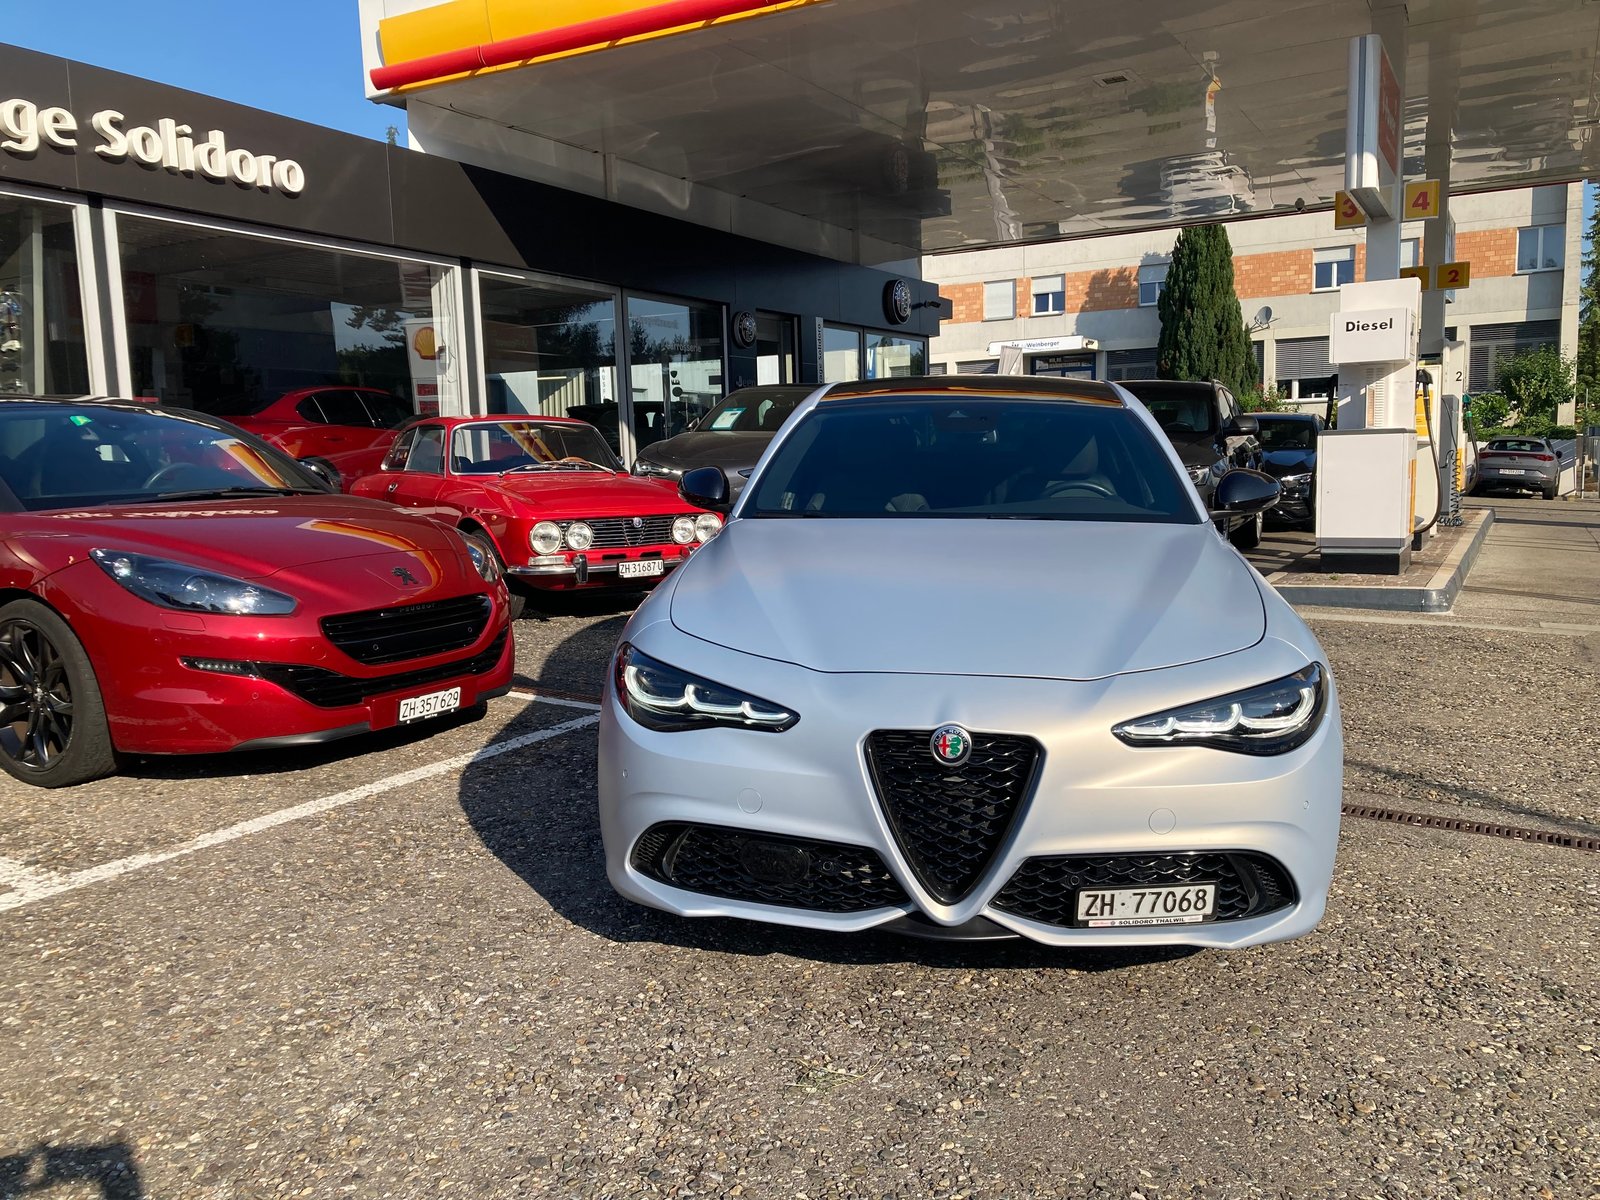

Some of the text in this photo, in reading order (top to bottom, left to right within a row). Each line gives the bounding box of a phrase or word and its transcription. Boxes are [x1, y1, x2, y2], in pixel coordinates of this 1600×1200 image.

[0, 98, 305, 193] ge Solidoro
[1342, 198, 1358, 218] 3
[1412, 192, 1430, 210] 4
[1448, 270, 1459, 283] 2
[1345, 318, 1393, 332] Diesel
[1455, 371, 1463, 381] 2
